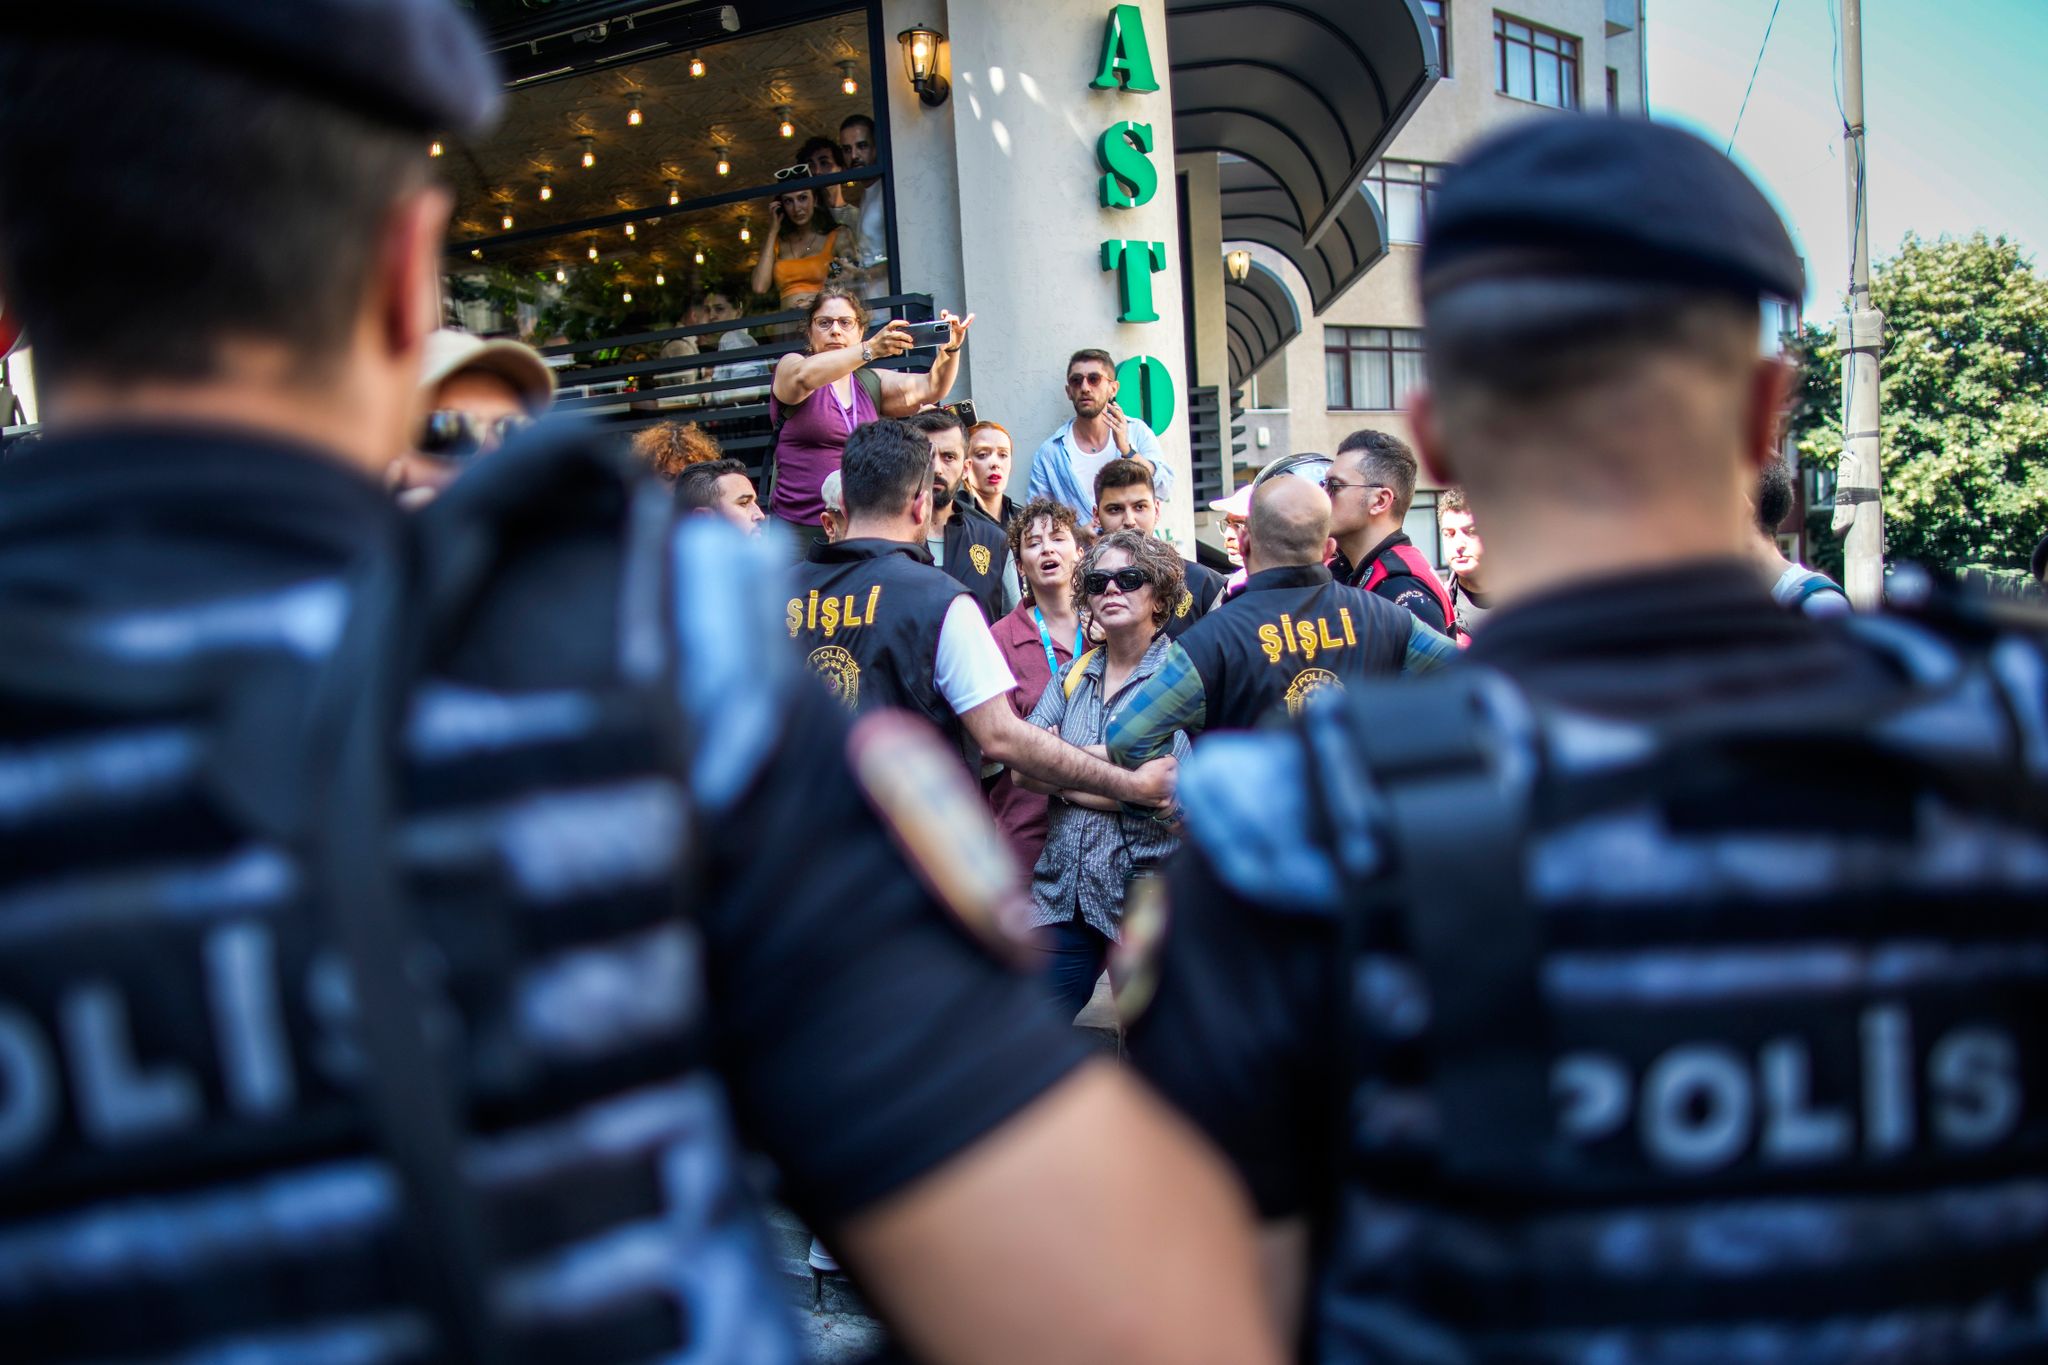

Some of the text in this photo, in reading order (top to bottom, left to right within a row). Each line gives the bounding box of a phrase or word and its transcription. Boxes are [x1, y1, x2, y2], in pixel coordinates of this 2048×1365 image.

[786, 585, 881, 637] ŞİŞLİ
[1259, 607, 1357, 663] ŞİŞLİ
[813, 649, 847, 663] POLİS
